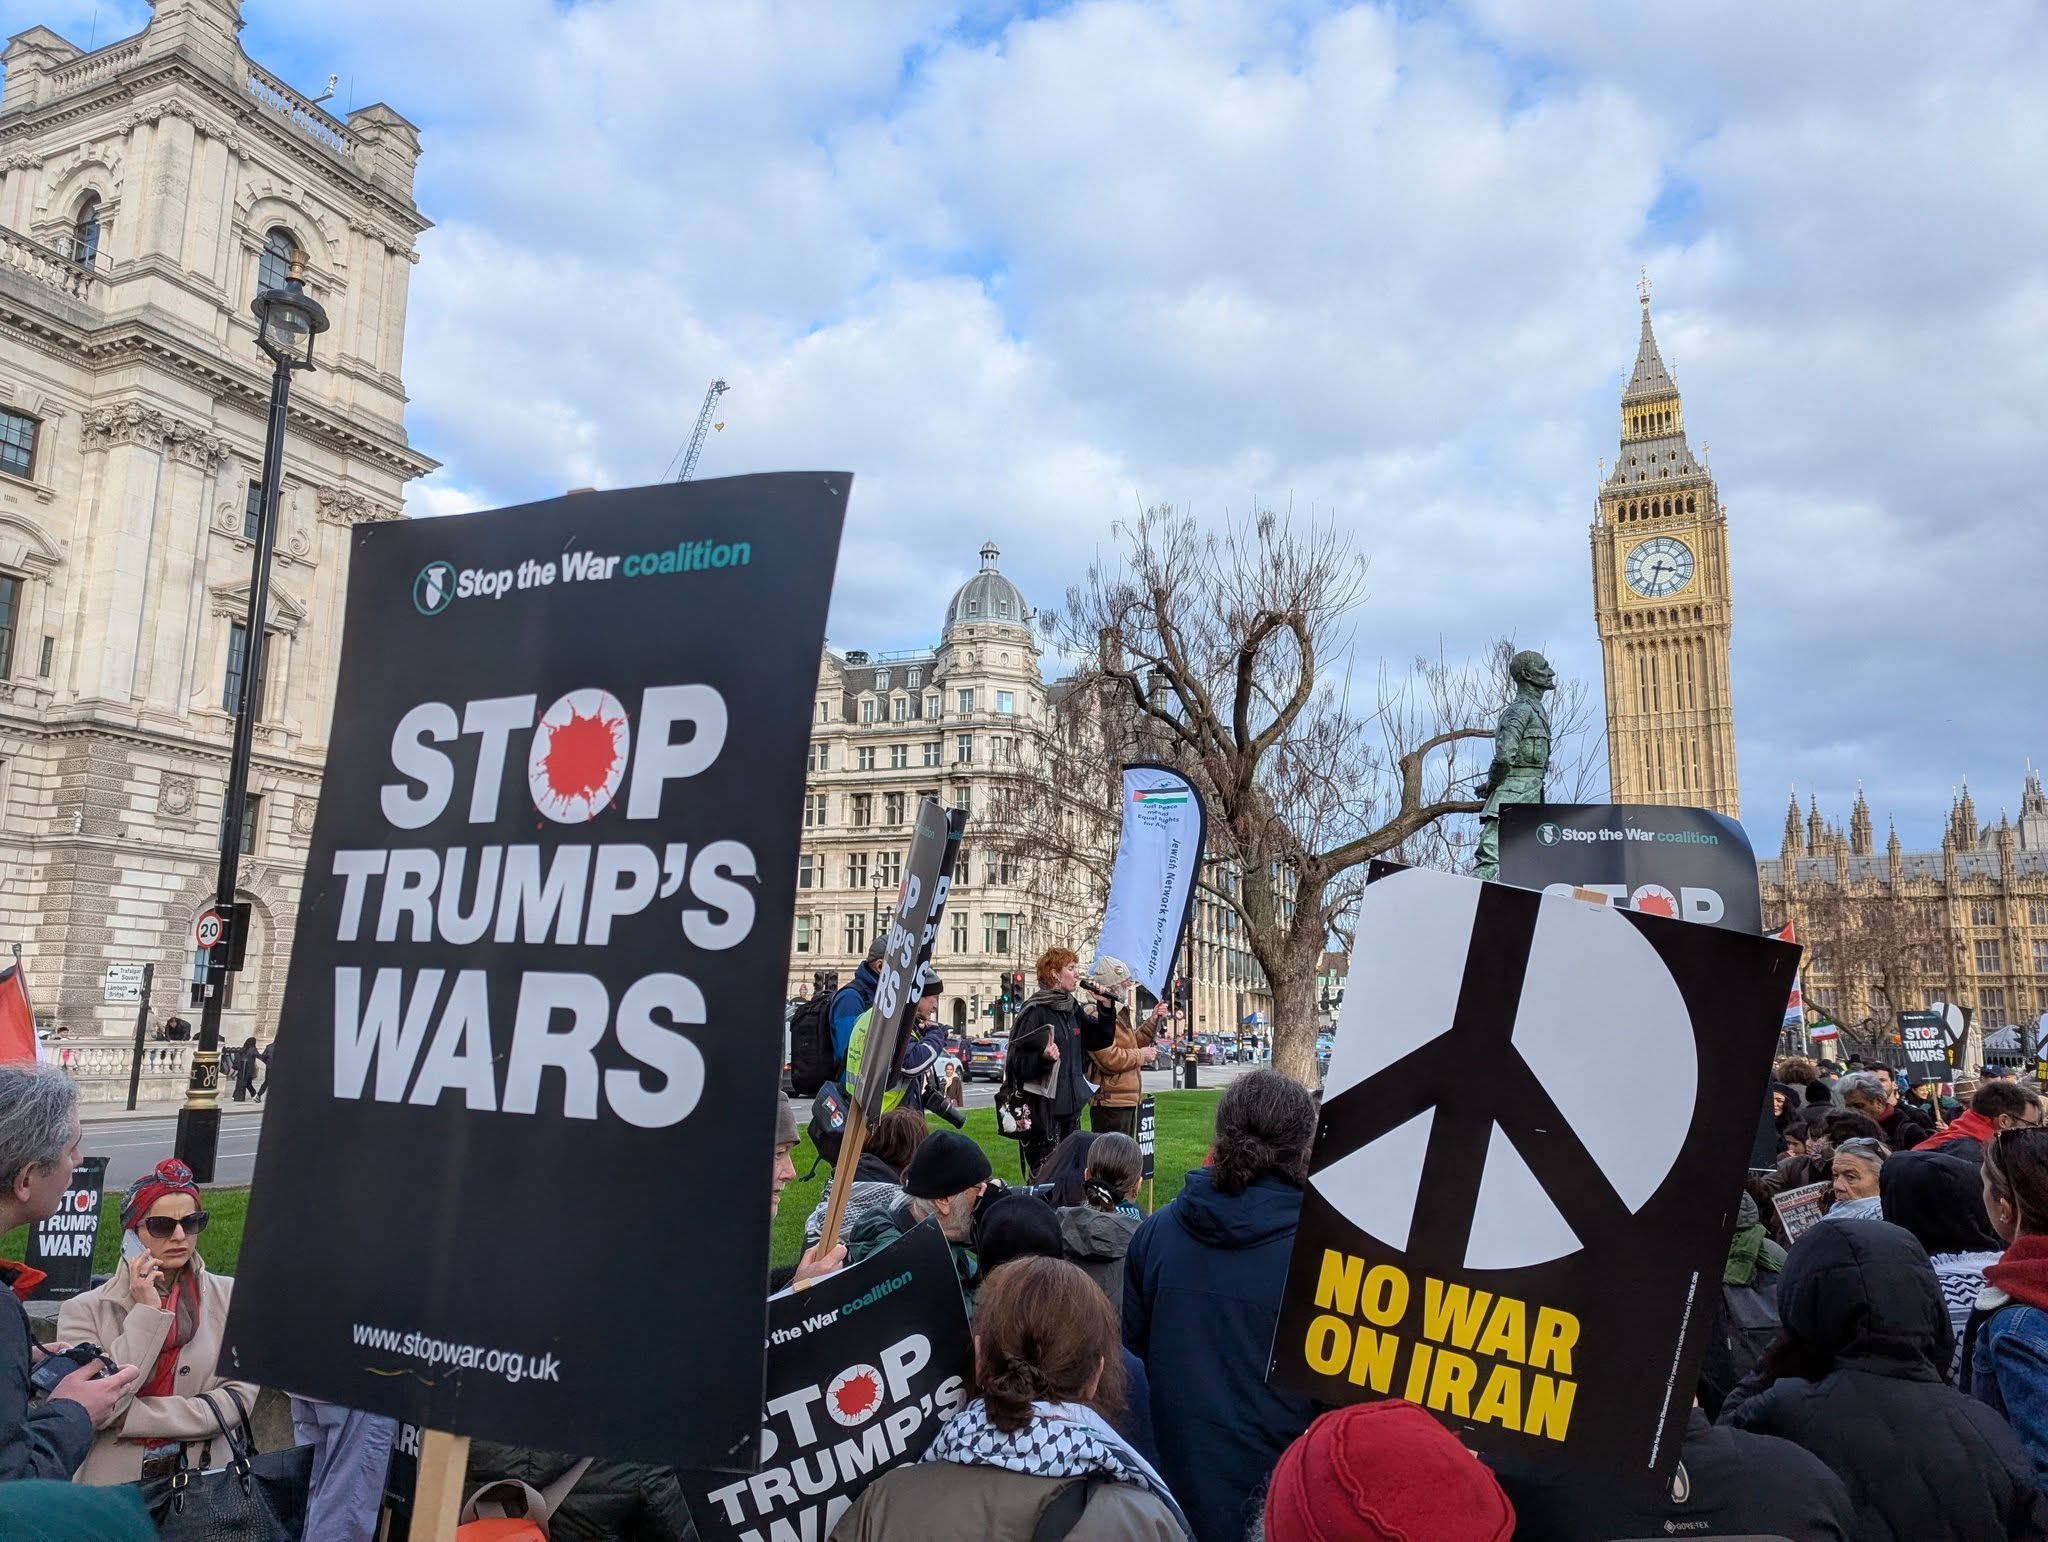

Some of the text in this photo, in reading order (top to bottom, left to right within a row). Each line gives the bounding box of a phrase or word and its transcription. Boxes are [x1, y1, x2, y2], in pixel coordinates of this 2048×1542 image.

[456, 539, 752, 600] Stop the War coalition
[380, 684, 729, 830] STOP
[1561, 827, 1719, 845] Stop the War coalition
[332, 840, 758, 951] TRUMP'S
[1148, 838, 1182, 979] Jewish Network for Palestin
[200, 923, 219, 938] 20
[120, 967, 142, 975] Trafalgar
[333, 966, 707, 1129] WARS
[1903, 1039, 1945, 1050] TRUMP'S
[1905, 1027, 1939, 1040] STOP
[1908, 1049, 1946, 1063] WARS
[39, 1234, 92, 1257] WARS
[771, 1327, 802, 1347] the
[802, 1308, 840, 1334] War
[841, 1269, 914, 1316] coalition
[1314, 1248, 1580, 1376] NO WAR
[353, 1323, 561, 1383] www.stopwar.org.uk
[1304, 1314, 1578, 1442] ON IRAN
[707, 1375, 968, 1526] TRUMP'S
[1648, 1443, 1659, 1469] Campaign
[1655, 1417, 1665, 1437] Nuclear
[1675, 1521, 1709, 1531] GORE-TEX
